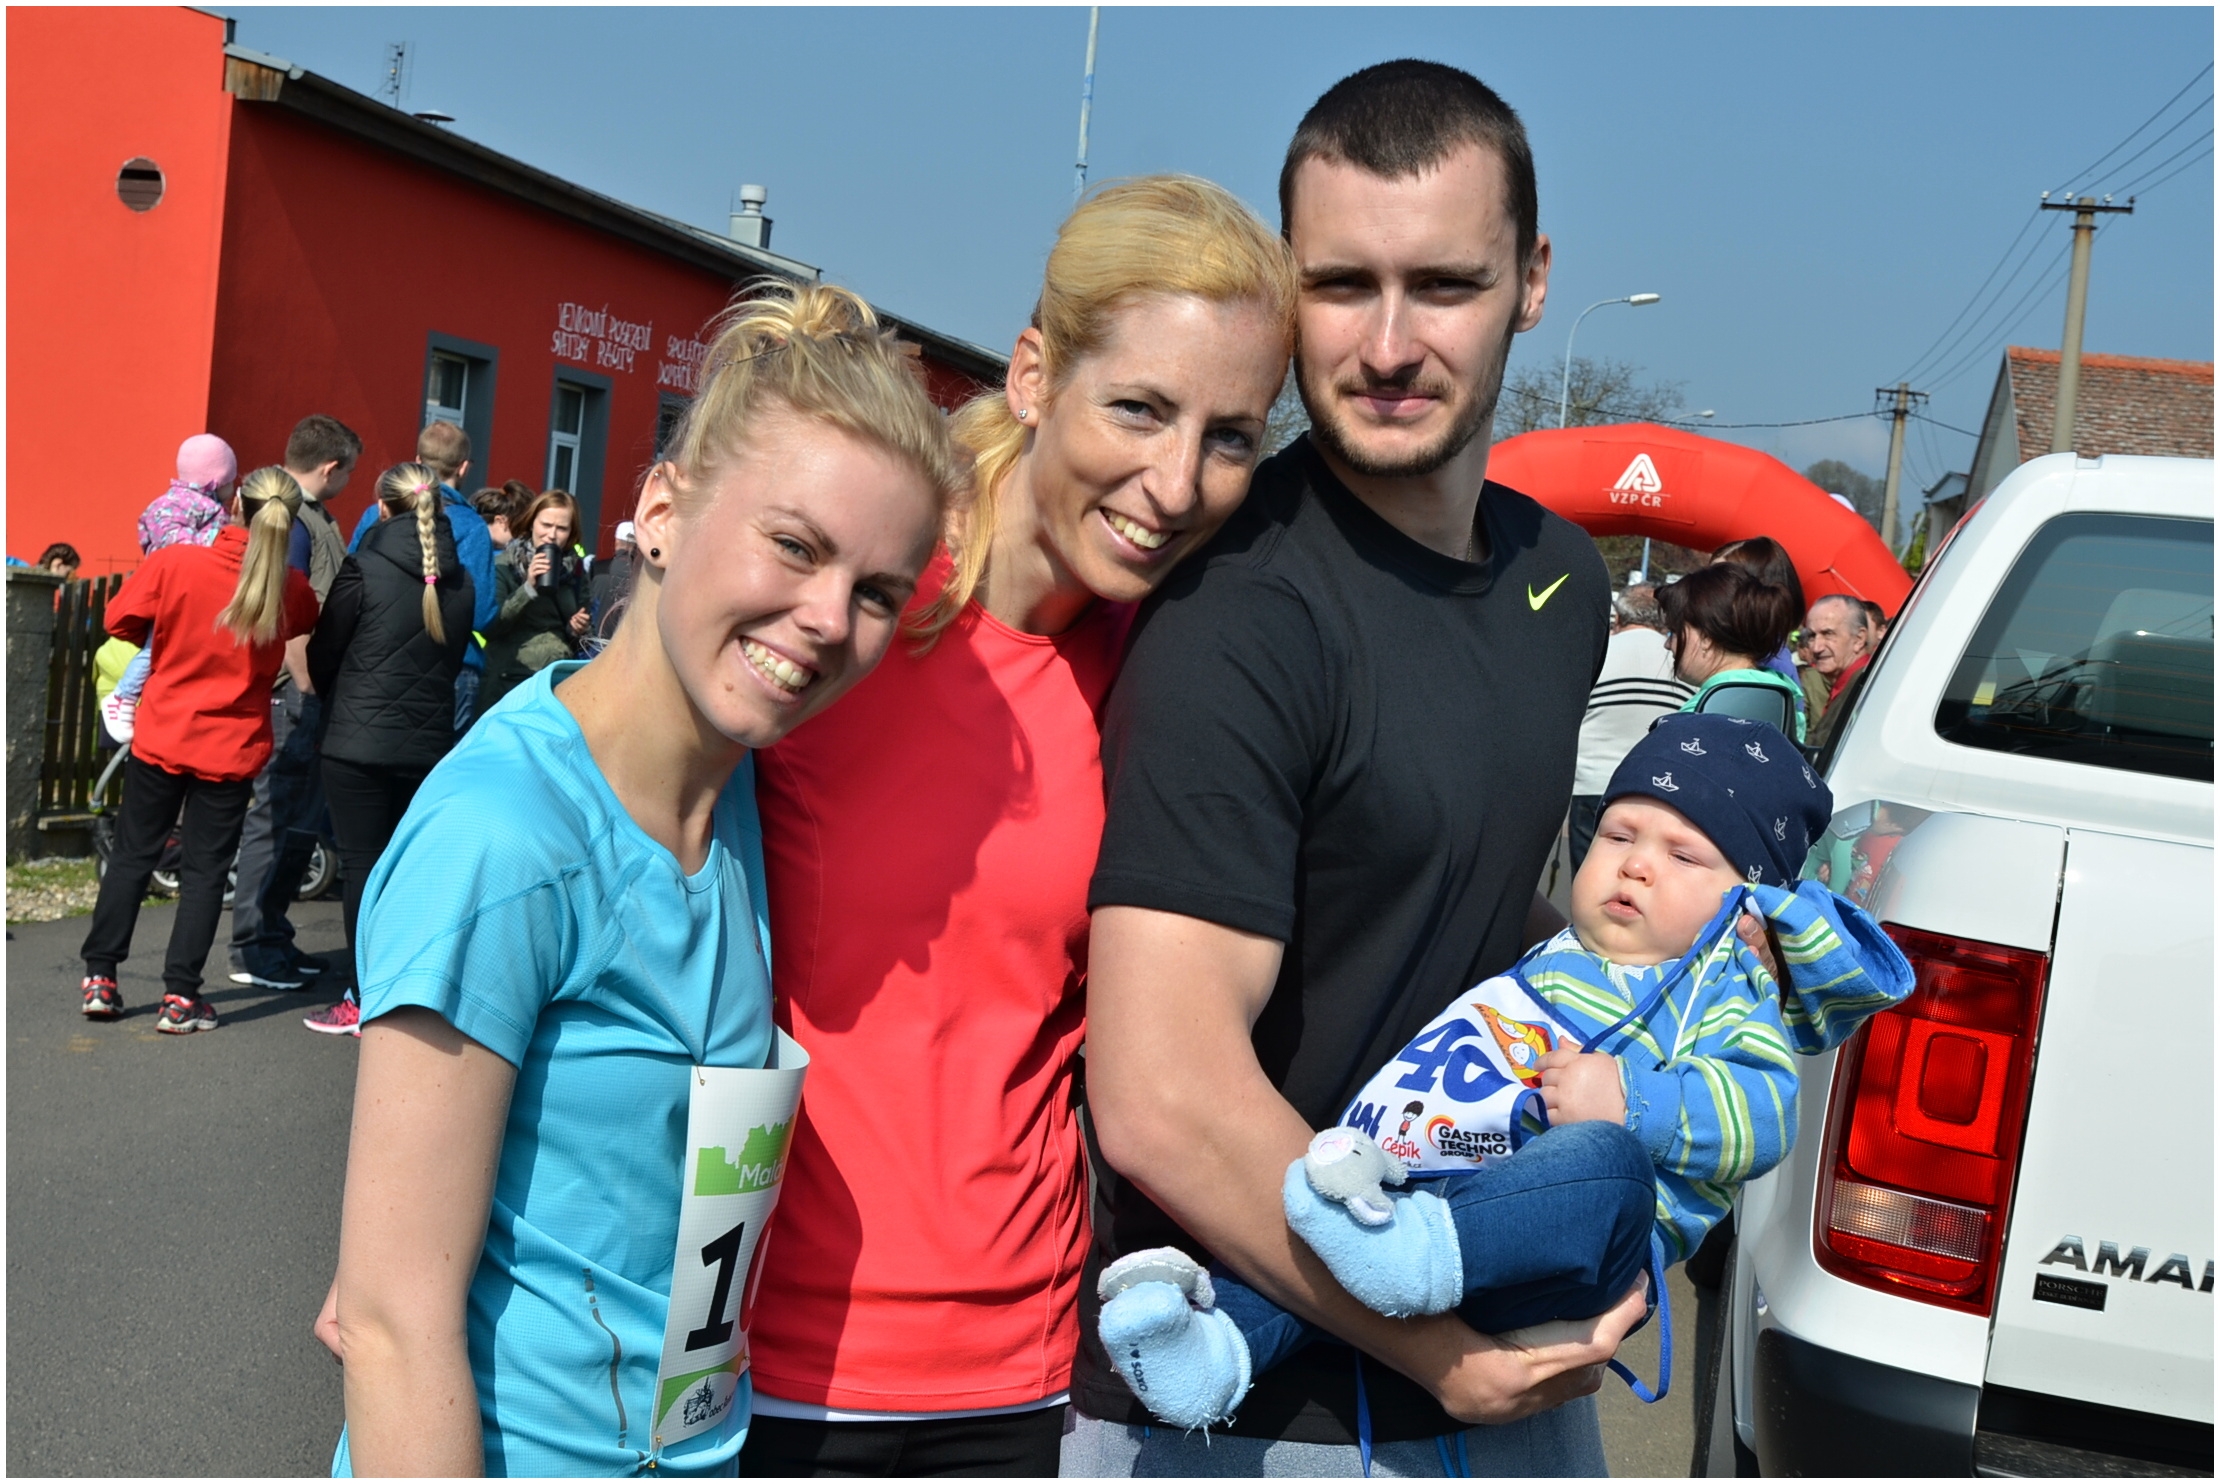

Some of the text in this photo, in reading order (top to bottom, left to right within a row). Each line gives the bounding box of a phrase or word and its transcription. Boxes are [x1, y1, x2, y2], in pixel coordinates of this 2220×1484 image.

[1609, 491, 1662, 507] VZP ČR
[1439, 1125, 1506, 1143] GASTRO
[1438, 1140, 1507, 1155] TECHNO
[738, 1156, 784, 1189] Malá
[2038, 1279, 2104, 1297] PORSCHE
